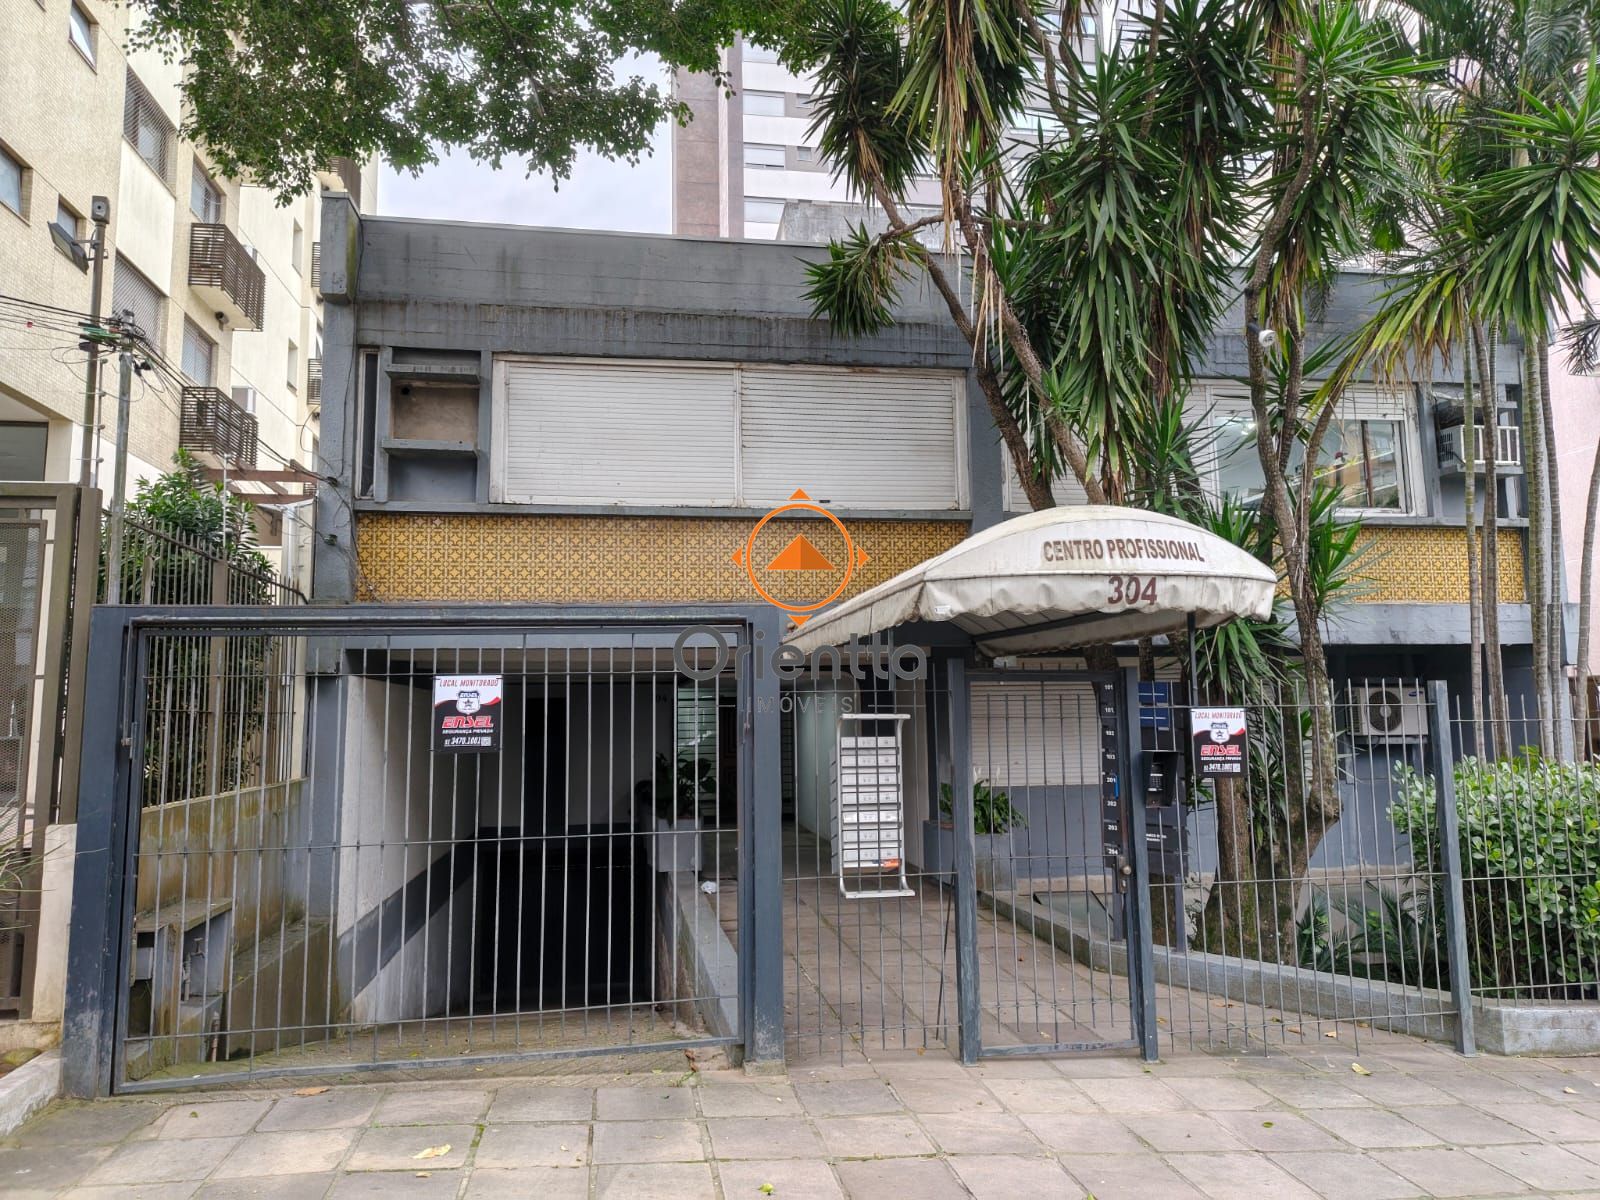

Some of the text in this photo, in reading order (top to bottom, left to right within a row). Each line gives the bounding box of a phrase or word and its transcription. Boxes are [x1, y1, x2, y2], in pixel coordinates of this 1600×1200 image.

[1044, 538, 1205, 563] CENTRO PROFISSIONAL
[1108, 575, 1157, 605] 304
[440, 679, 498, 687] LOCAL MONITORADO
[1195, 711, 1242, 719] LOCAL MONITORADO
